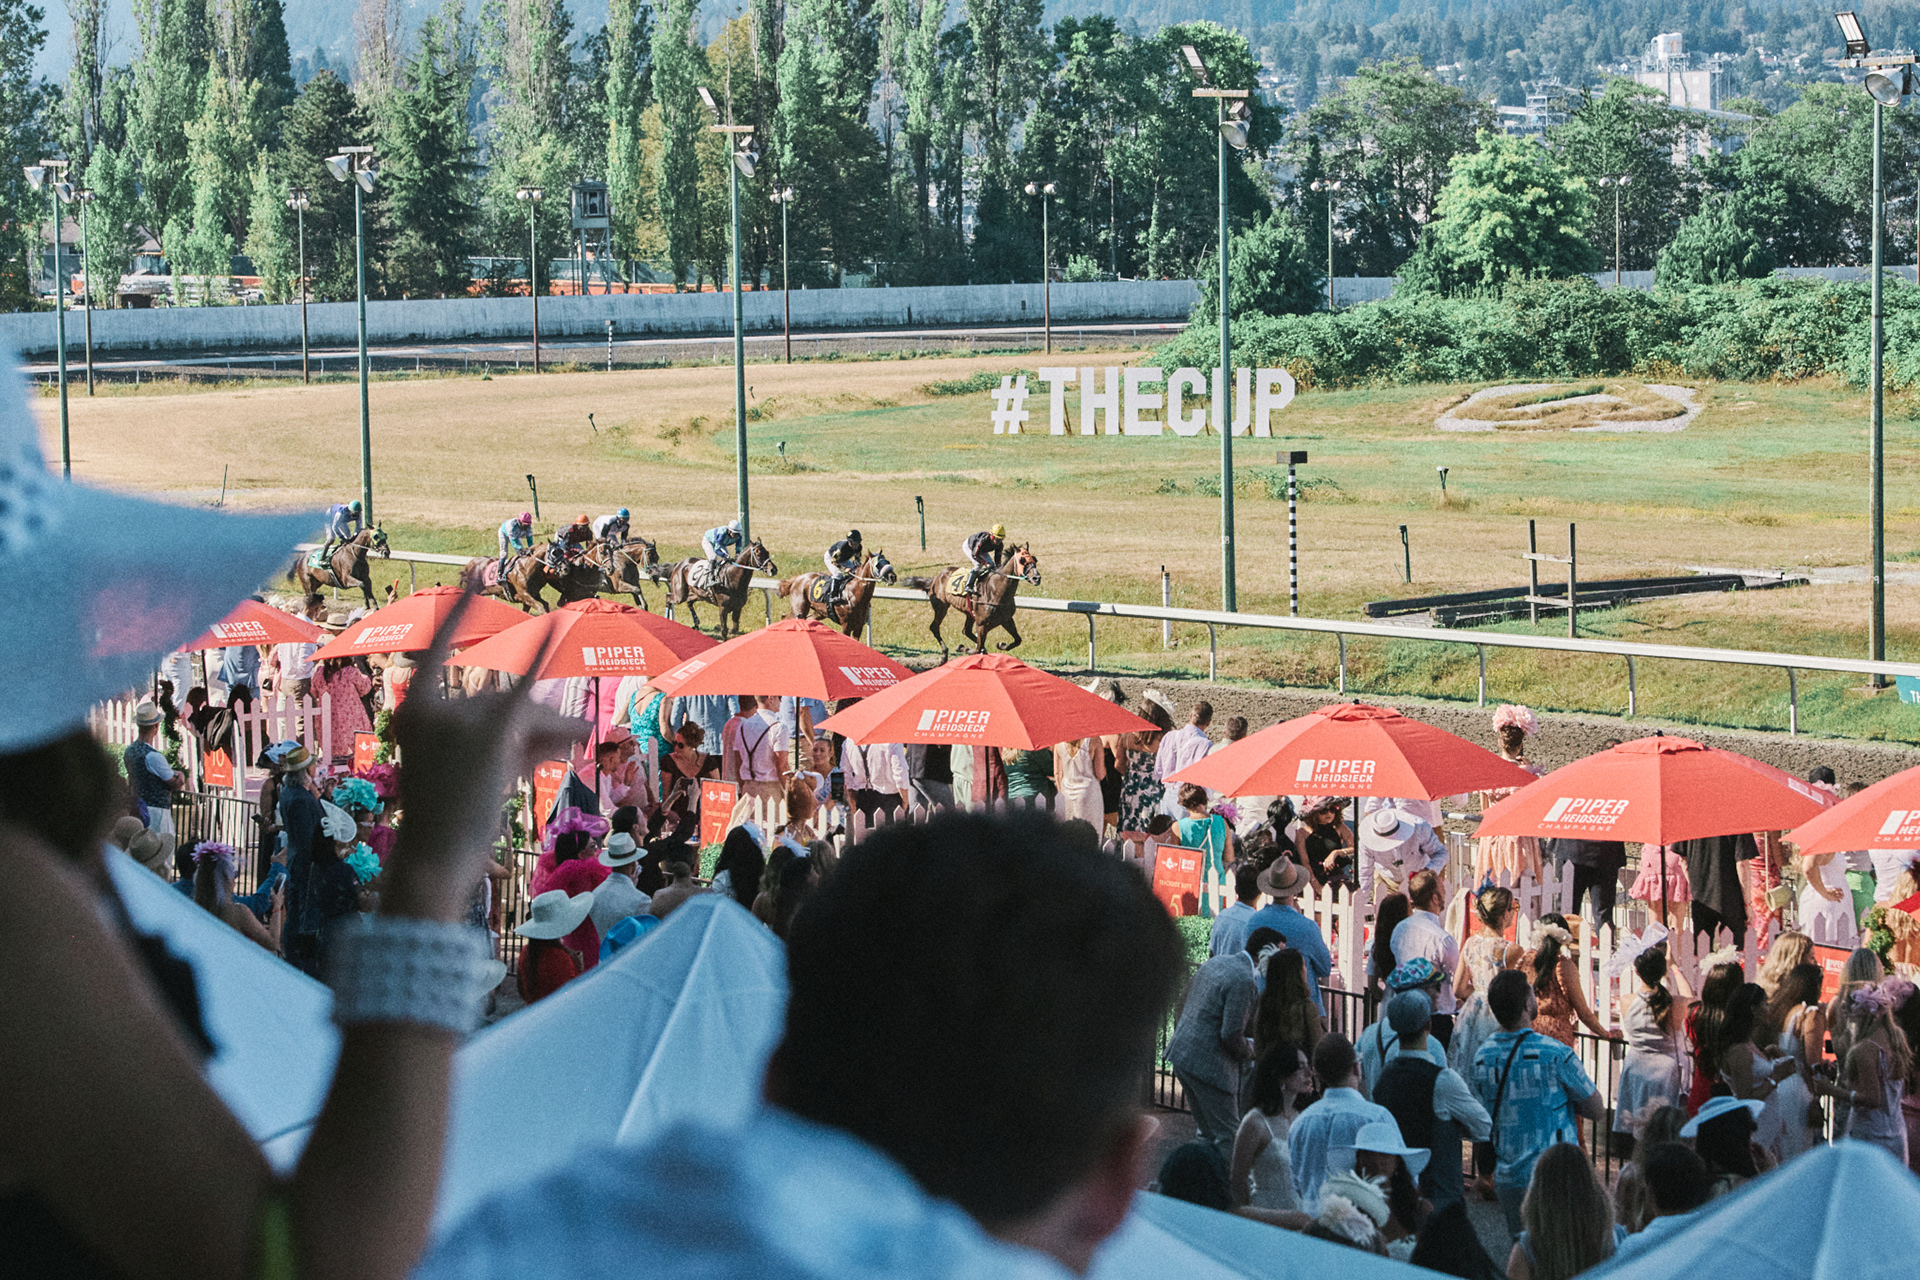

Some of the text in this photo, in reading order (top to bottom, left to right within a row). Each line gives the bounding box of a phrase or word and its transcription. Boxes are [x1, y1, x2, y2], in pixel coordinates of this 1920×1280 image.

[991, 367, 1295, 437] #THECUP
[813, 579, 826, 599] 6
[951, 575, 964, 592] 4
[221, 621, 264, 632] PIPER
[371, 623, 413, 636] PIPER
[227, 630, 268, 639] HEIDSIECK
[596, 646, 645, 658] PIPER
[599, 658, 646, 666] HEIDSIECK
[850, 666, 896, 679] PIPER
[936, 709, 990, 724] PIPER
[932, 723, 986, 733] HEIDSIECK
[914, 731, 984, 739] CHAMPAGNE
[212, 746, 225, 767] 10
[1315, 759, 1376, 774] PIPER
[1314, 773, 1373, 783] HEIDSIECK
[545, 798, 553, 820] 8
[1567, 798, 1630, 815] PIPER
[1560, 813, 1619, 824] HEIDSIECK
[712, 822, 722, 843] 7
[1537, 823, 1612, 832] CHAMPAGNE
[1170, 894, 1180, 917] 5
